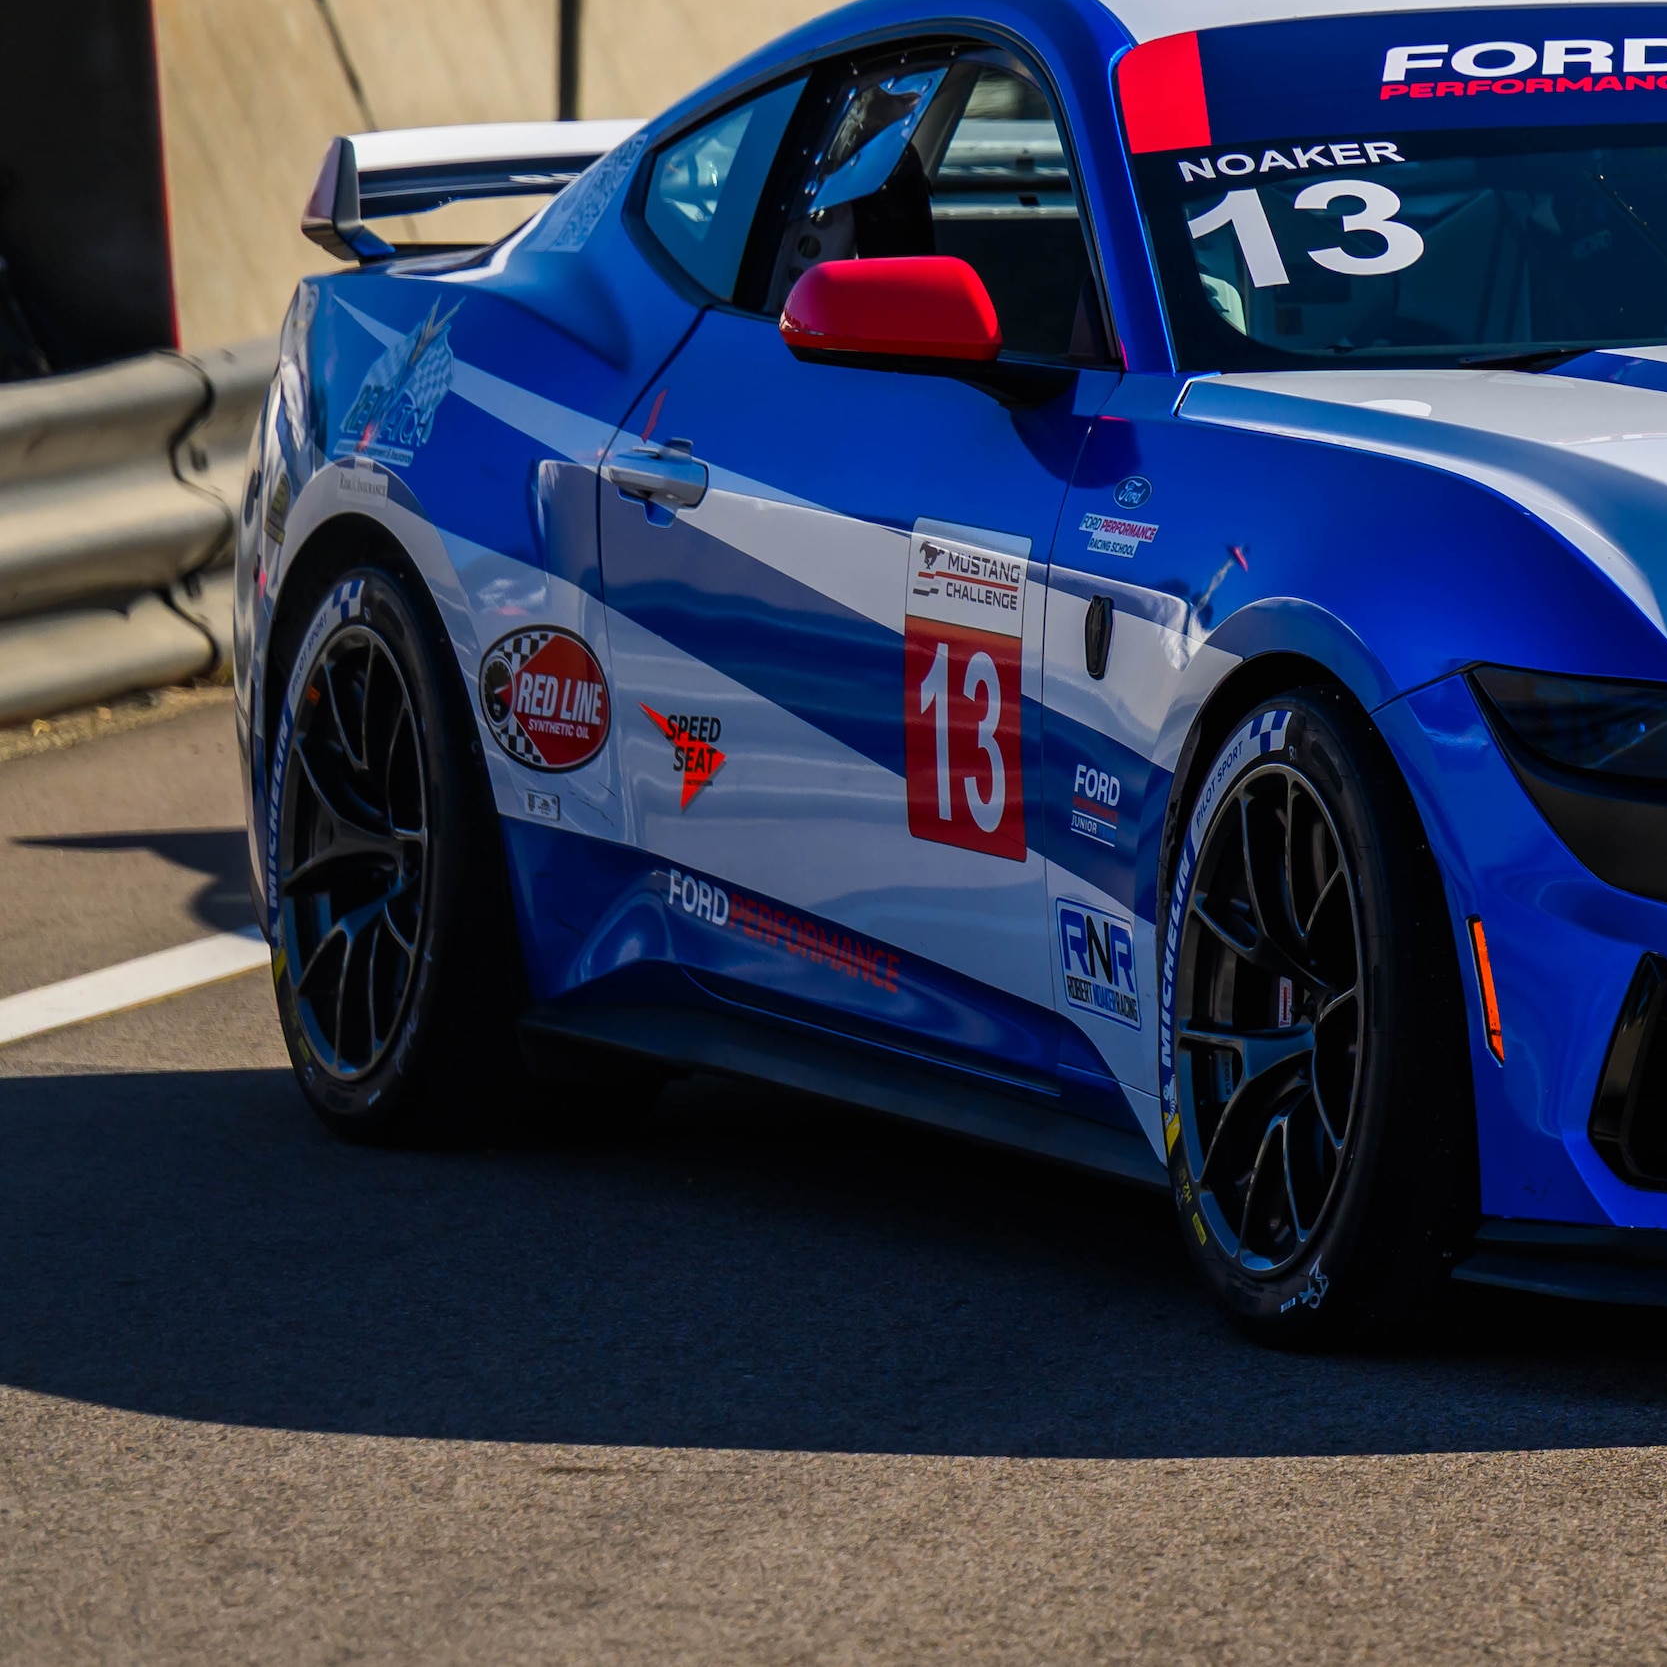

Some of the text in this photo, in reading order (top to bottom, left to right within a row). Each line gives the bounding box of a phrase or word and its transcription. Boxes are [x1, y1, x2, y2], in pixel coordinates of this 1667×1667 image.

[1178, 141, 1406, 182] NOAKER
[1187, 179, 1425, 288] 13
[1118, 479, 1146, 504] Ford
[1082, 515, 1157, 541] FORD PERFORMANCE
[1090, 537, 1134, 555] RACING SCHOOL
[947, 552, 1021, 584] MUSTANG
[945, 581, 1018, 611] CHALLENGE
[516, 671, 603, 725] RED LINE
[528, 718, 590, 739] SYNTHETIC OIL
[667, 715, 722, 743] SPEED
[920, 642, 1007, 833] 13
[673, 746, 718, 774] SEAT
[1217, 740, 1244, 783] SPORT
[1074, 763, 1120, 807] FORD
[1196, 777, 1216, 828] PILOT
[268, 714, 289, 908] MICHELIN
[1071, 814, 1098, 834] JUNIOR
[667, 869, 900, 994] FORD PERFORMANCE
[1060, 908, 1136, 994] RNR
[1161, 848, 1190, 1067] MICHELIN
